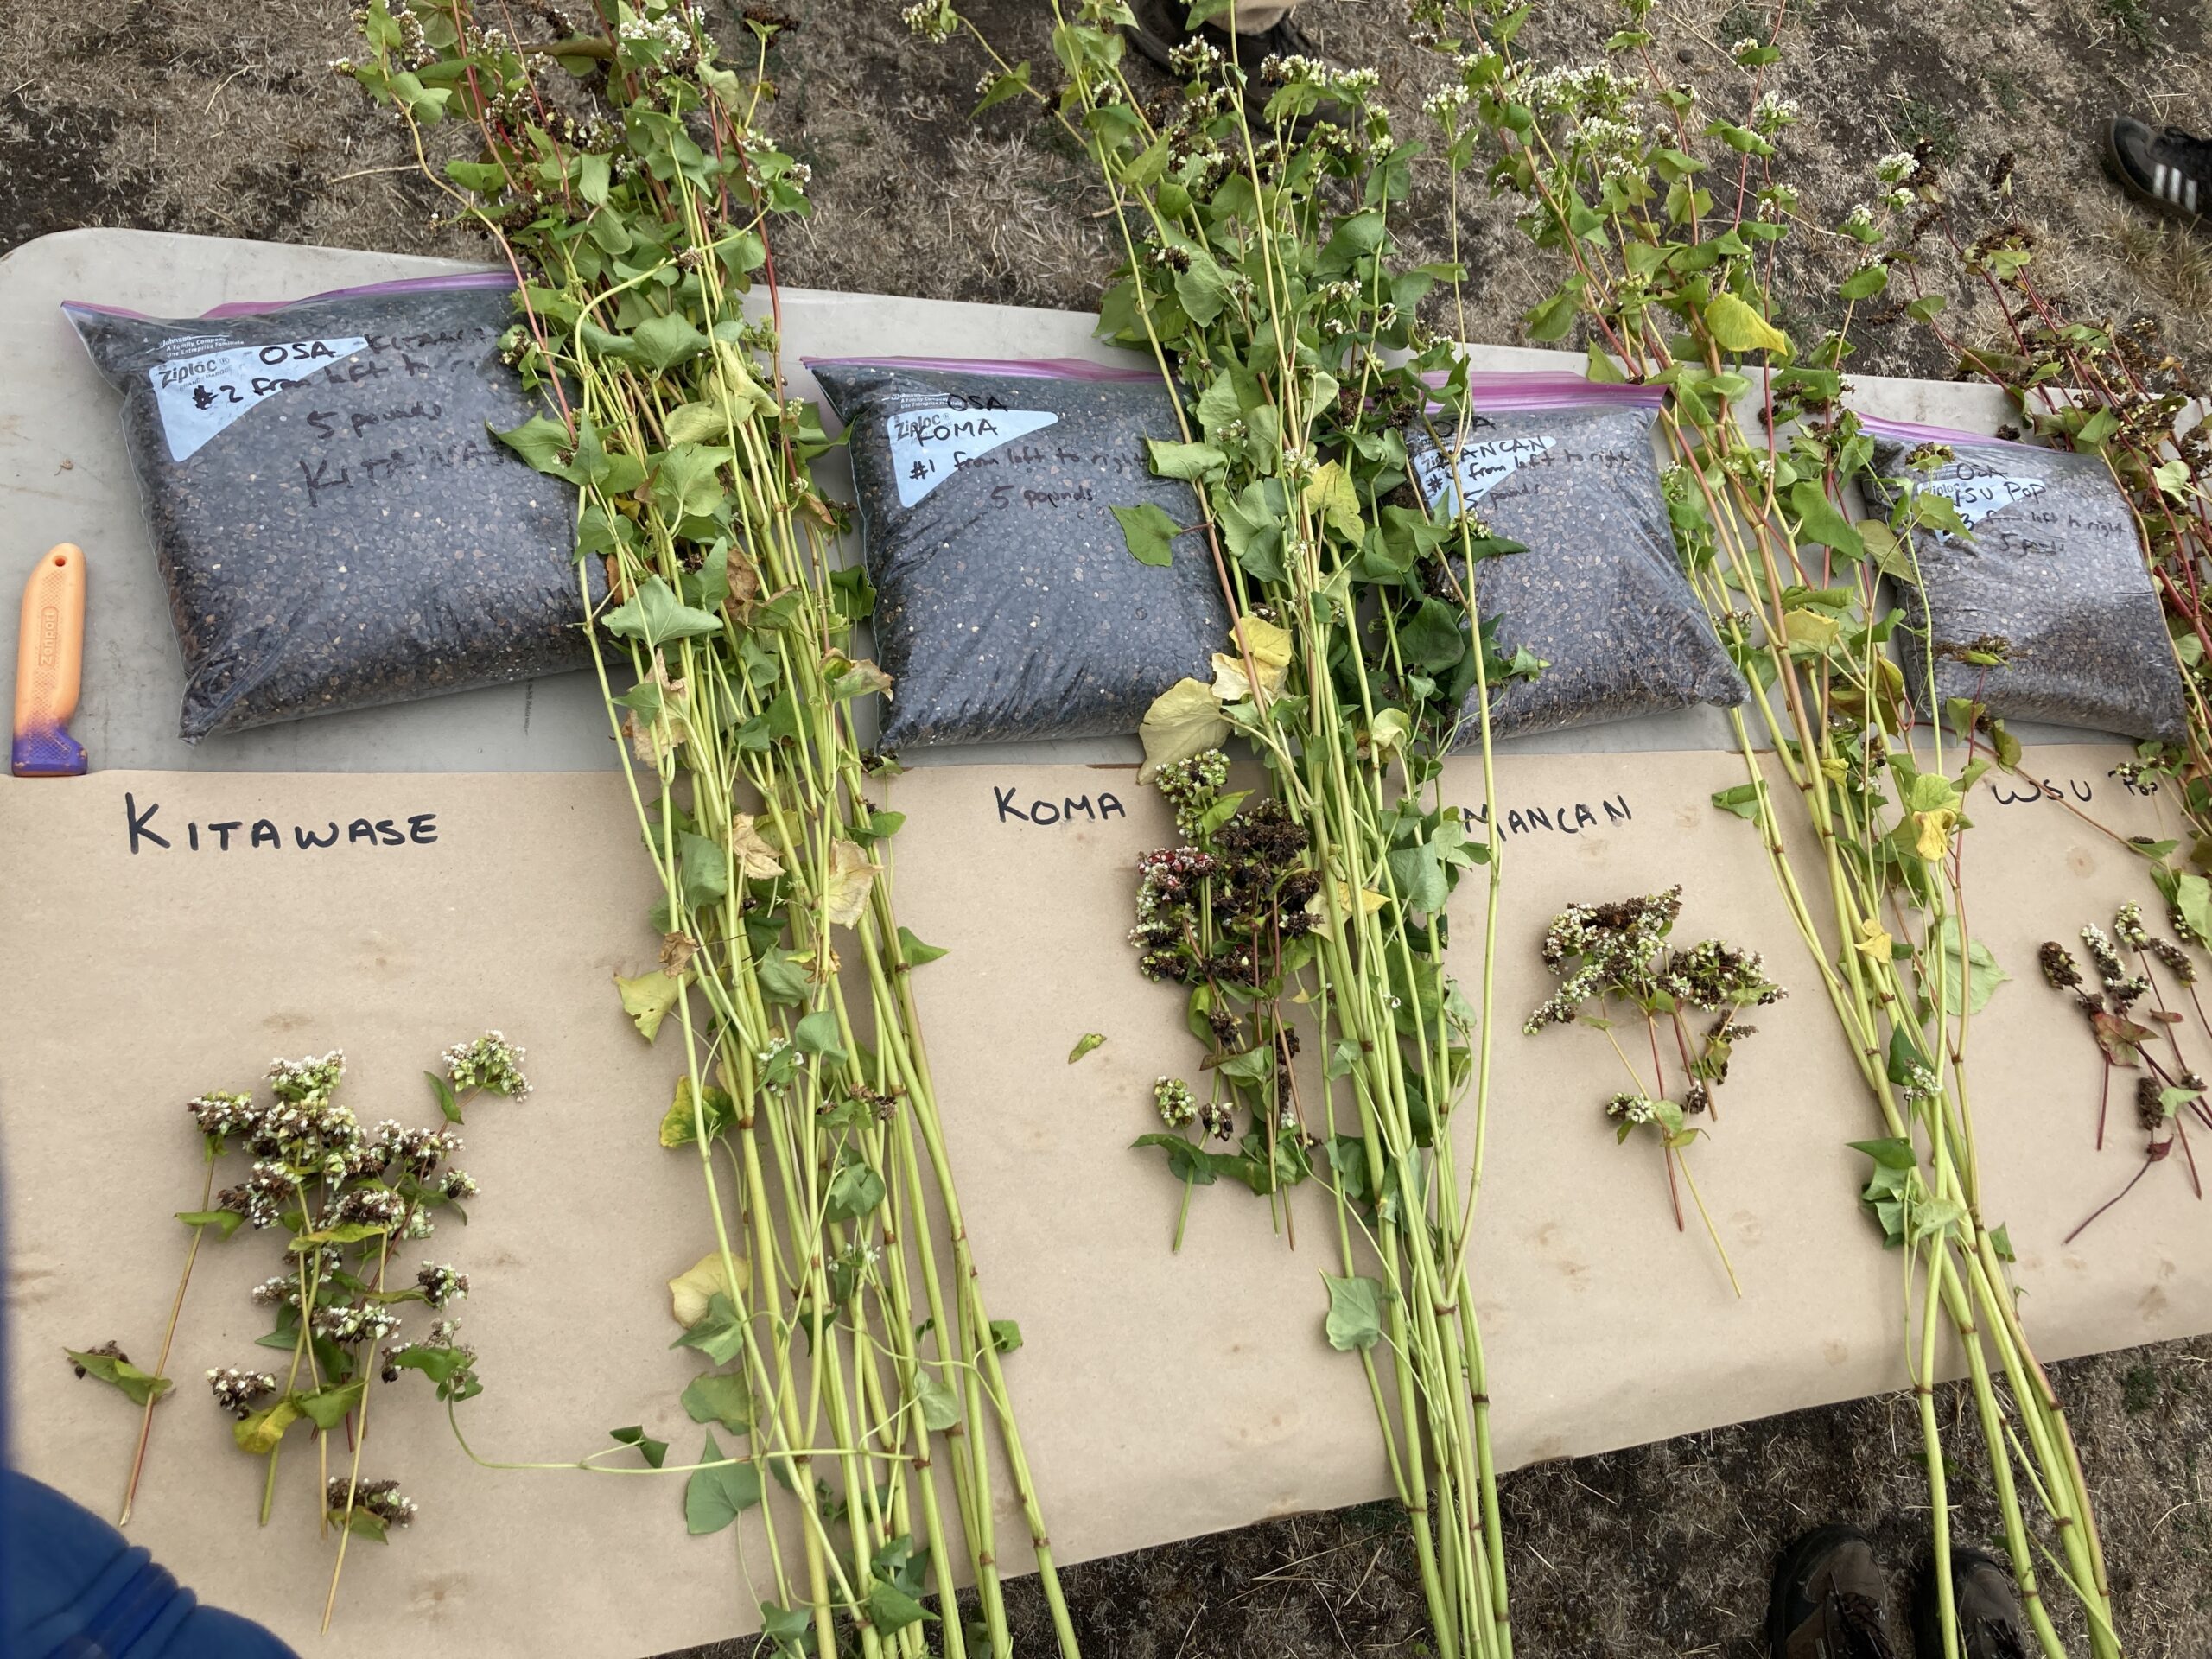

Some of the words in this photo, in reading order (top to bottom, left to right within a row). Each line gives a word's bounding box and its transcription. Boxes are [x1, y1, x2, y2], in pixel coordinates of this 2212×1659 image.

[173, 341, 195, 351] Family
[195, 337, 227, 346] Company
[181, 344, 213, 355] Entreprise
[259, 341, 336, 365] OSA
[158, 359, 218, 389] Ziploc
[948, 393, 1007, 412] OSA
[894, 414, 941, 441] Ziploc
[913, 418, 999, 447] KOMA
[909, 459, 936, 480] #1
[954, 451, 999, 471] from
[1007, 446, 1046, 465] left
[1056, 447, 1080, 465] to
[1469, 462, 1507, 480] from
[1514, 450, 1555, 470] left
[1590, 449, 1630, 468] right
[991, 485, 1014, 510] 5
[1489, 483, 1540, 510] pounds
[2088, 520, 2127, 537] right
[41, 610, 57, 665] Zenport
[994, 785, 1127, 825] KOMA
[1991, 779, 2093, 805] WSU
[125, 792, 439, 855] KITAWASE
[1463, 794, 1632, 842] MANCAN
